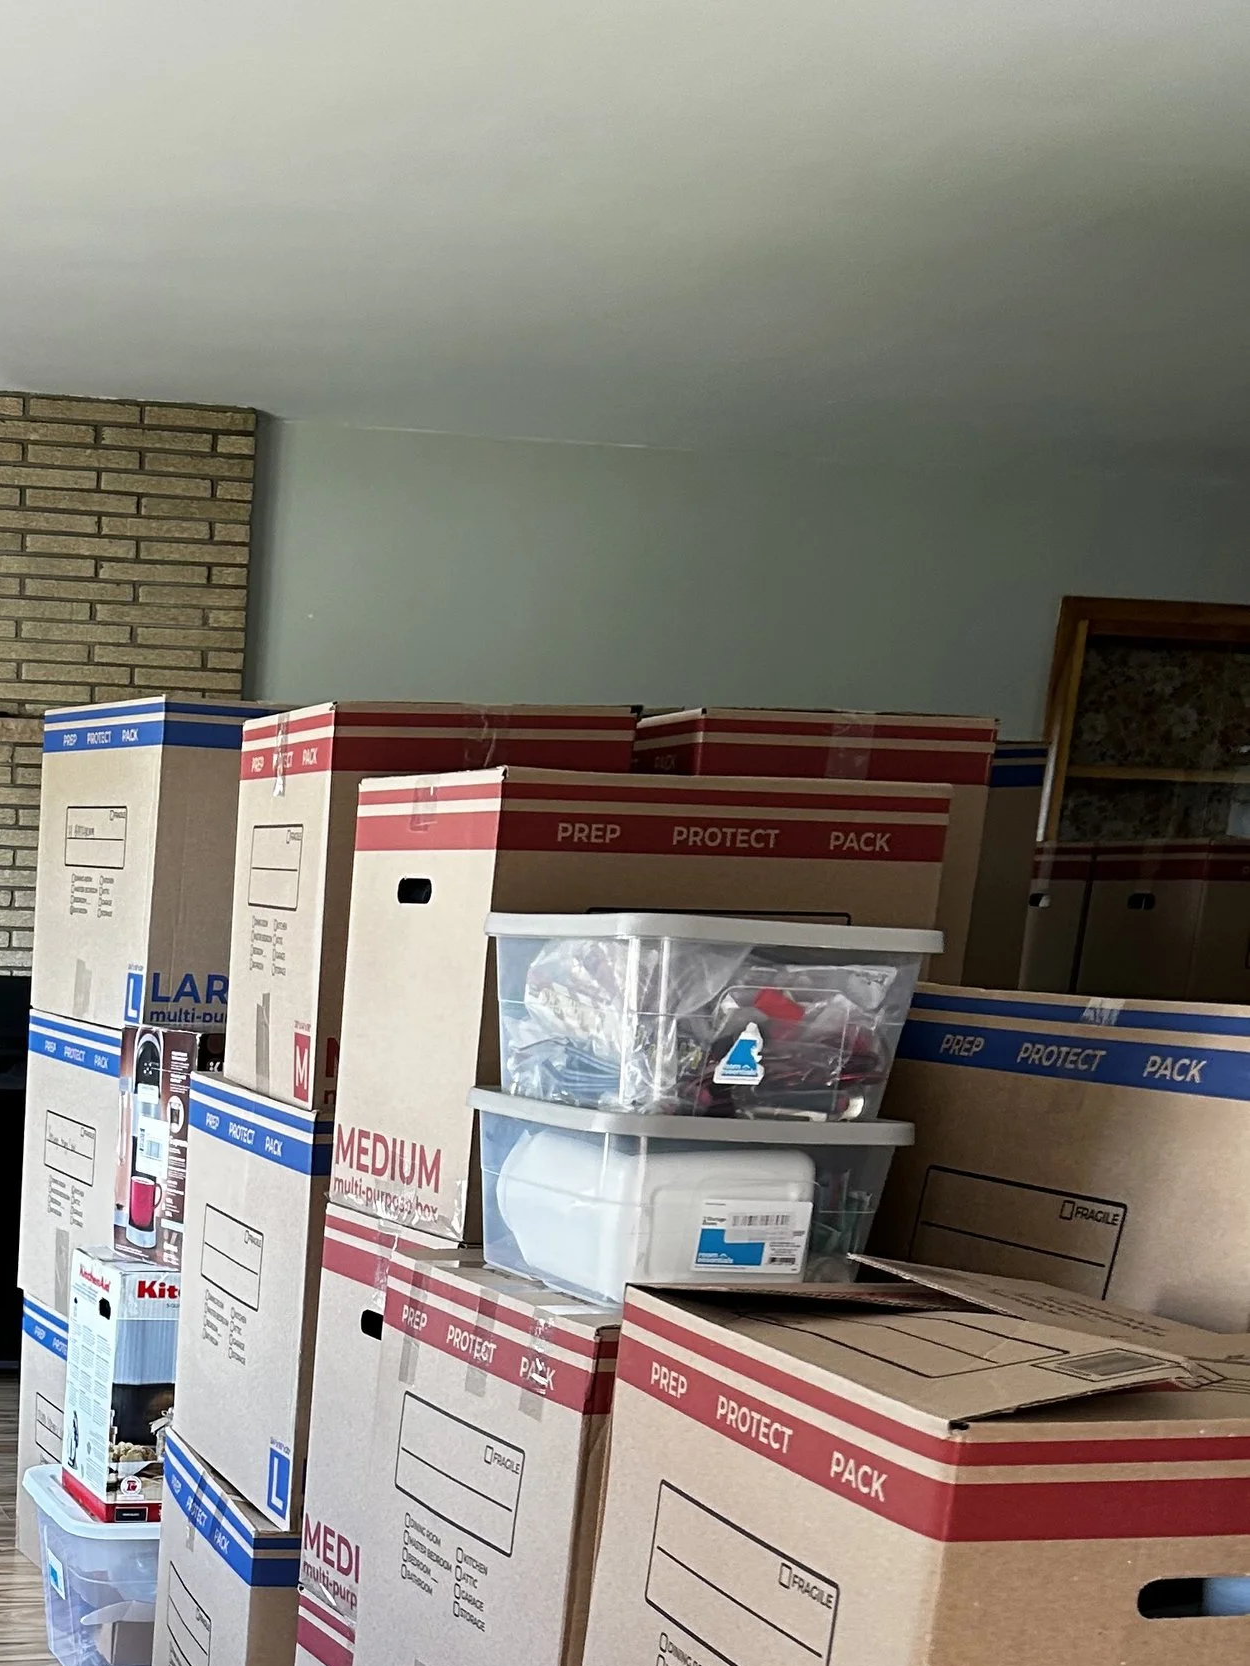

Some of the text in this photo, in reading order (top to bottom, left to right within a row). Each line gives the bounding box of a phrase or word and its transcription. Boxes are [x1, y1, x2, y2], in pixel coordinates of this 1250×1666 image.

[63, 729, 138, 747] PREP PROTECT PACK
[251, 756, 265, 773] PREP
[302, 747, 318, 766] PACK
[556, 822, 892, 853] PREP PROTECT PACK
[63, 1045, 86, 1063] PROTECT
[94, 1054, 109, 1070] PACK
[295, 1045, 308, 1091] M
[940, 1034, 1208, 1084] PREP PROTECT PACK
[205, 1112, 283, 1157] PREP PROTECT PACK
[335, 1124, 442, 1194] MEDIUM
[1075, 1206, 1120, 1226] FRAGILE
[137, 1280, 181, 1299] Kit
[402, 1304, 556, 1391] PREP PROTECT PAK
[650, 1361, 889, 1502] PREP PROTECT PACK
[493, 1452, 521, 1475] FRAGILE
[271, 1457, 283, 1509] L
[171, 1473, 230, 1554] PREP PROTECT PACK
[462, 1572, 479, 1589] ATTIC
[463, 1554, 489, 1576] KITCHEN
[791, 1575, 834, 1610] FRAGILE
[460, 1607, 486, 1633] STORAGE
